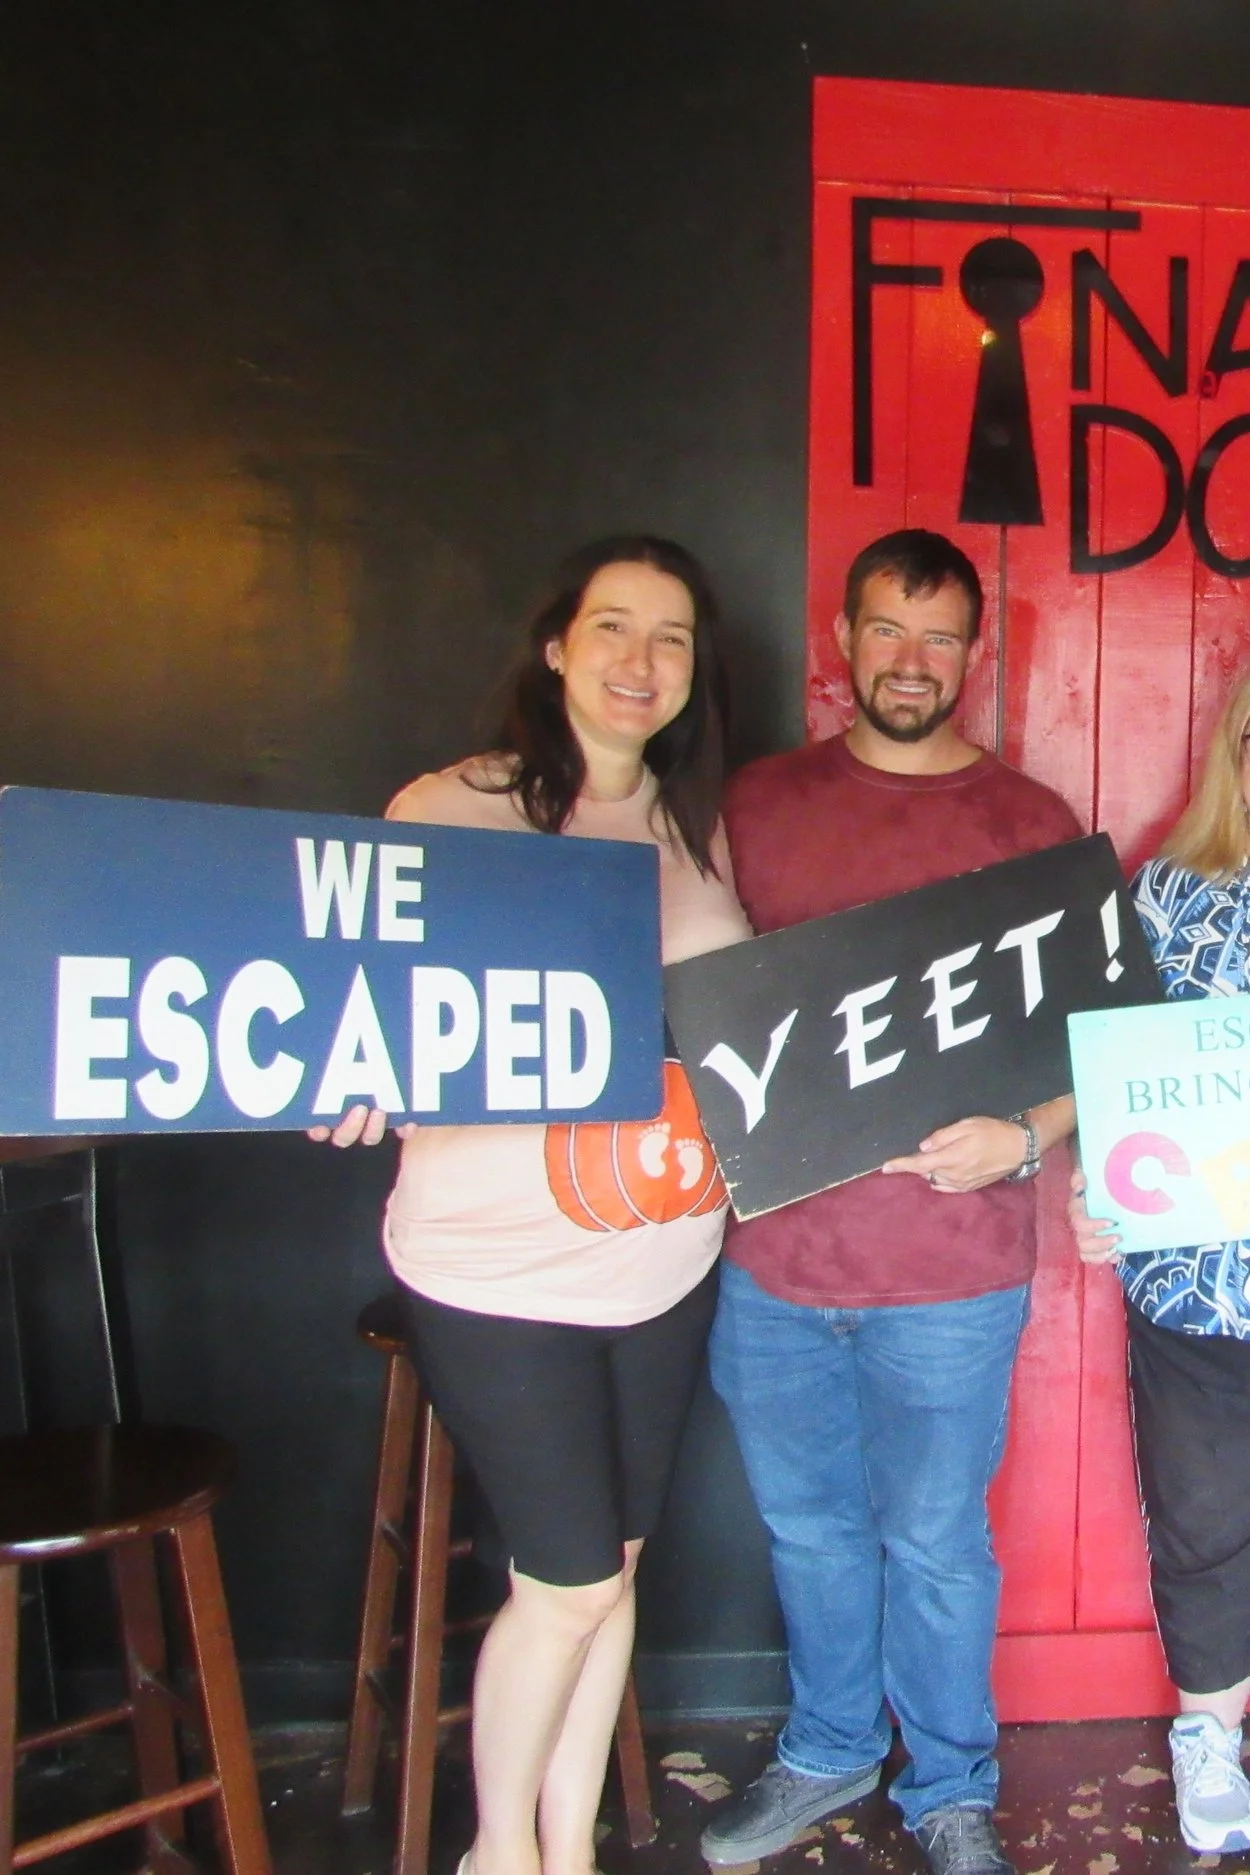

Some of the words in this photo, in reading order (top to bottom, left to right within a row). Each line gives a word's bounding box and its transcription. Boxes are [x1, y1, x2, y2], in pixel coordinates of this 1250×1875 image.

[296, 838, 424, 942] WE
[53, 955, 612, 1121] ESCAPED
[701, 889, 1125, 1134] YEET!
